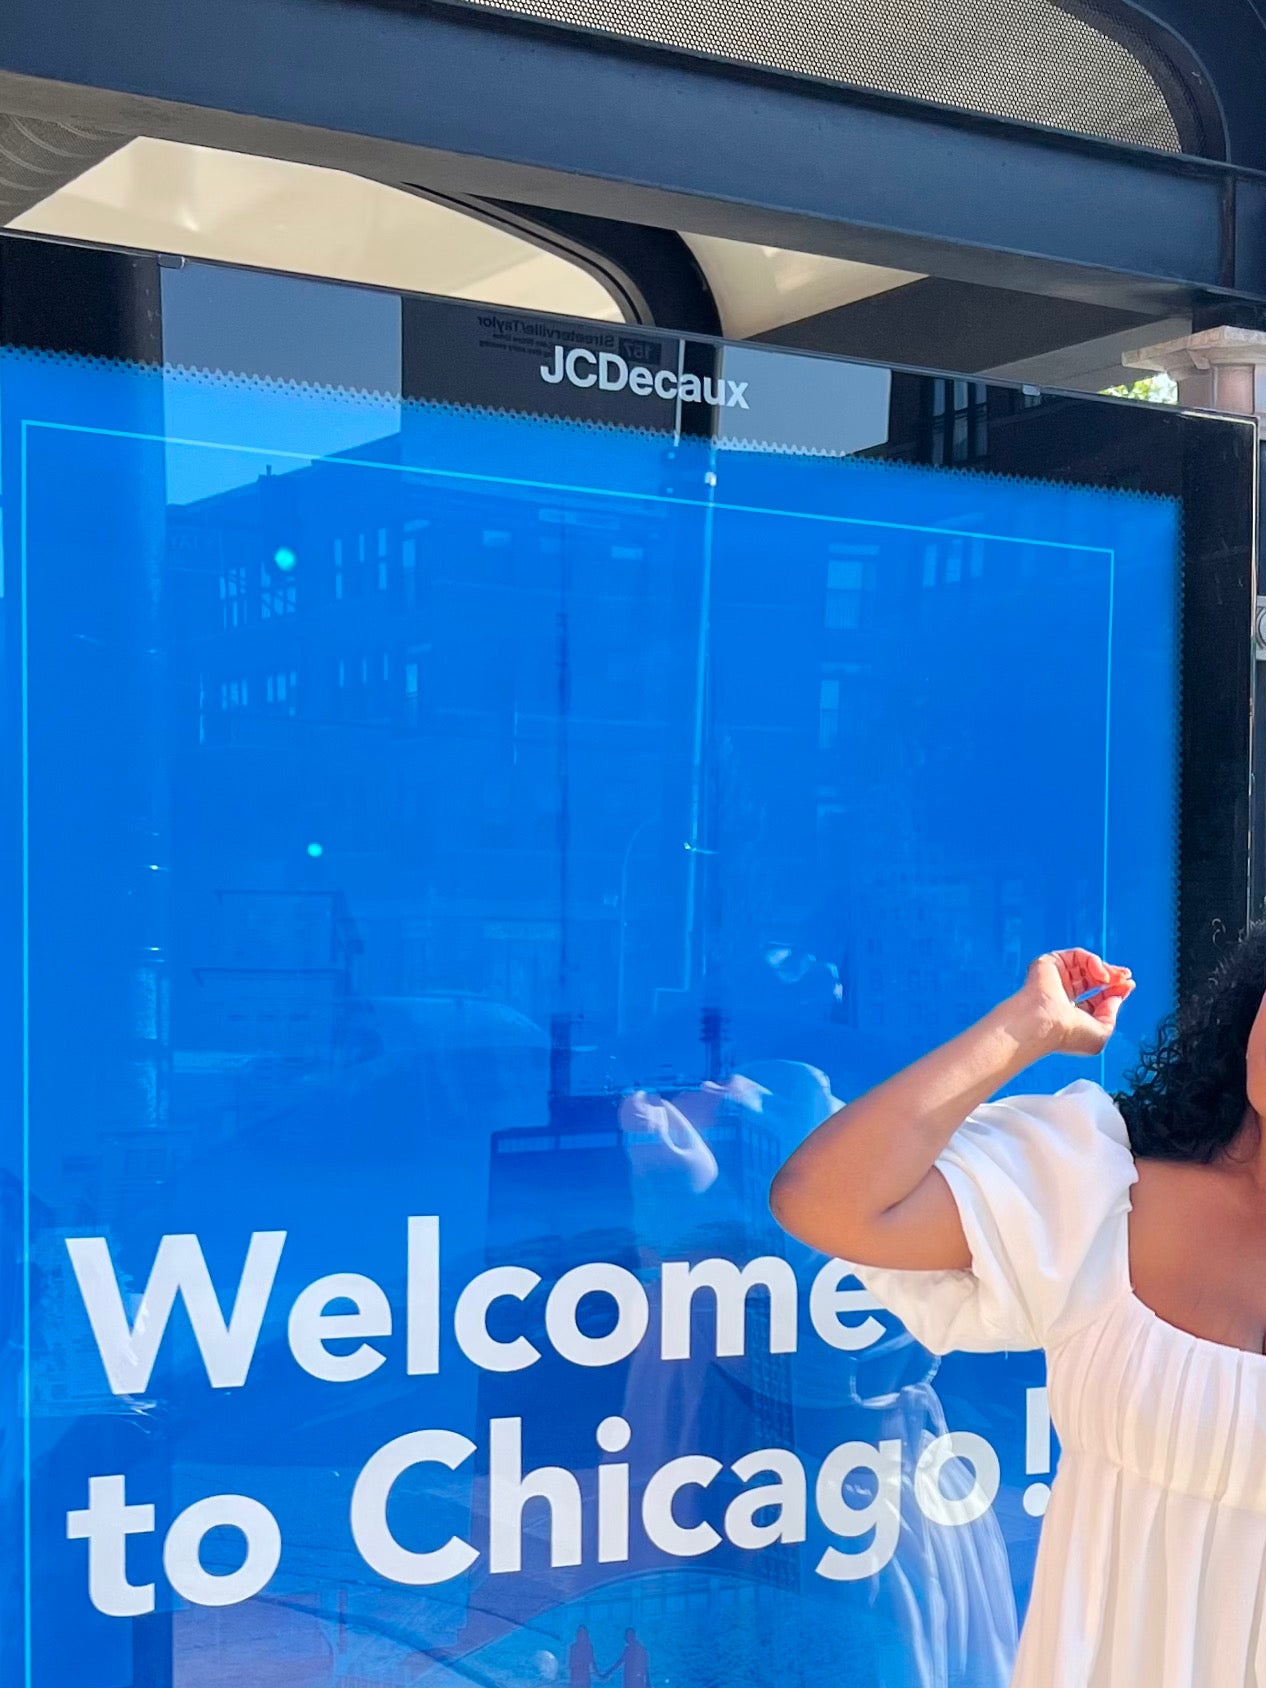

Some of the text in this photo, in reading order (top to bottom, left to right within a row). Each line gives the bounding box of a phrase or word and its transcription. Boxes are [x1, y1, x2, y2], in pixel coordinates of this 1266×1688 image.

[540, 346, 749, 409] JCDecaux
[66, 1215, 887, 1394] Welcome
[66, 1387, 1051, 1616] to Chicago!
